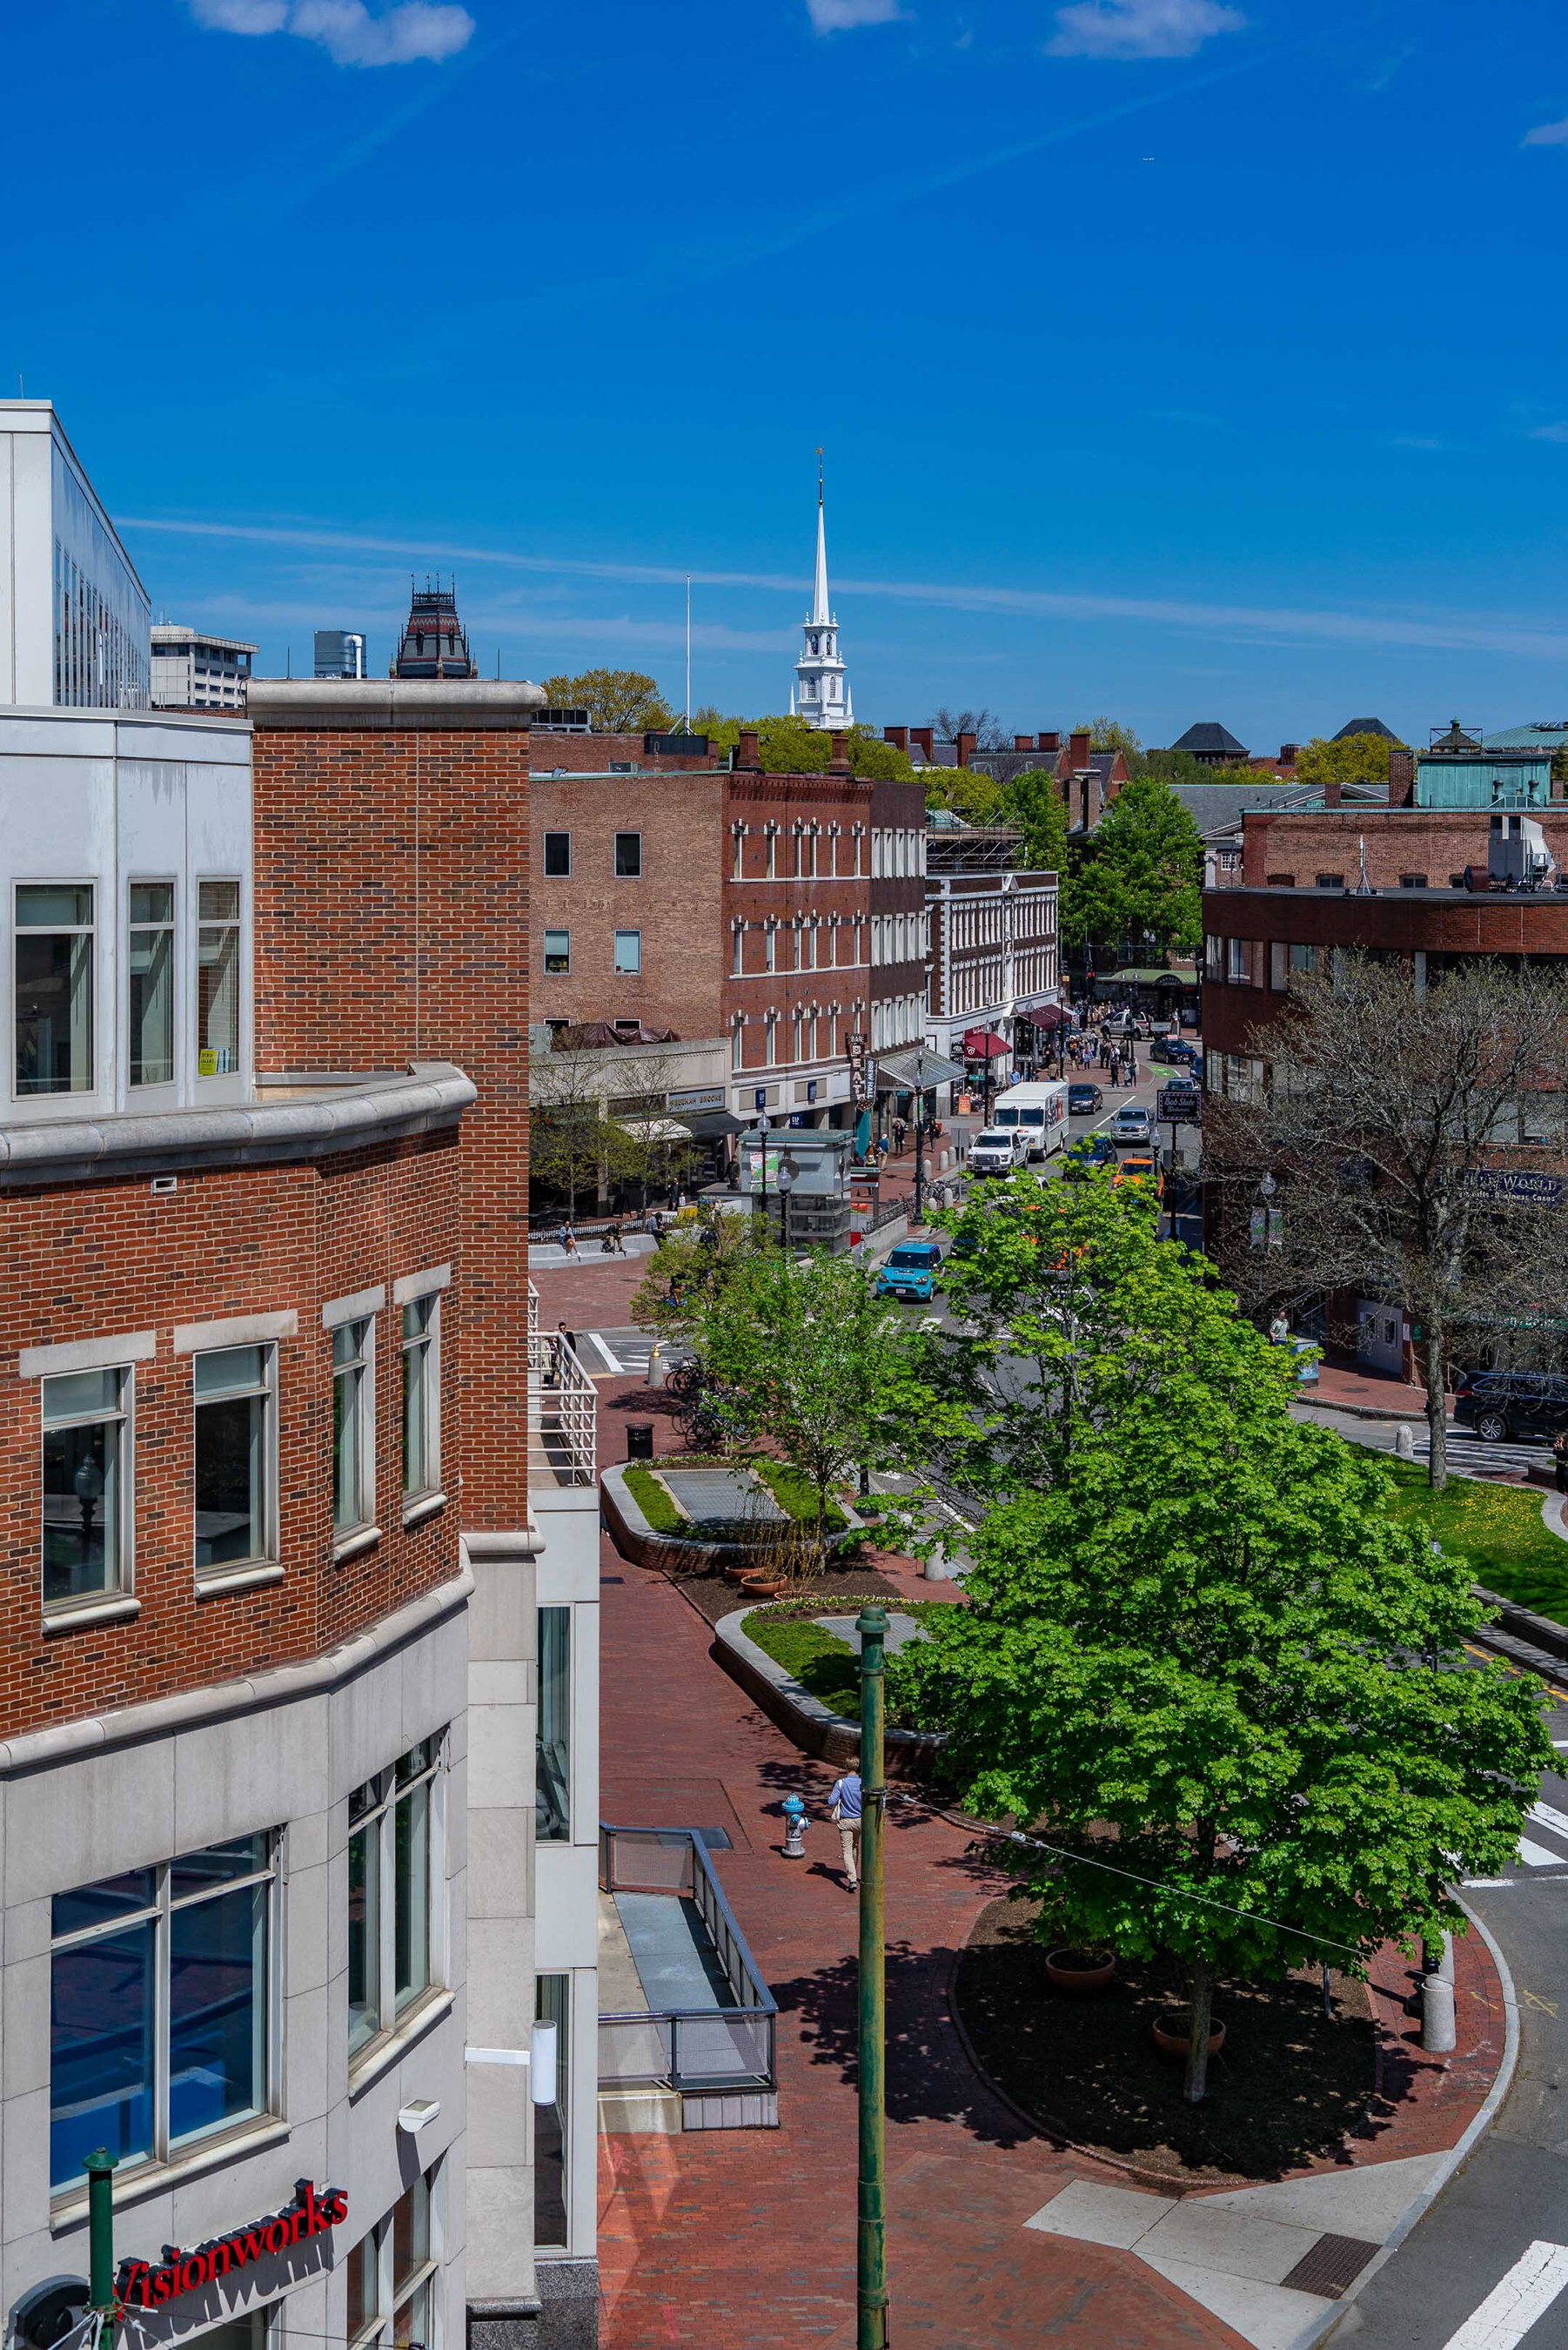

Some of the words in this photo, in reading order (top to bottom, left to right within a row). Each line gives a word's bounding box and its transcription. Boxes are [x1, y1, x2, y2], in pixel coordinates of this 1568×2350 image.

[852, 1045, 862, 1094] BEAT
[1164, 1097, 1178, 1105] Bob
[1504, 1175, 1557, 1192] WORLD
[111, 2179, 348, 2321] Visionworks
